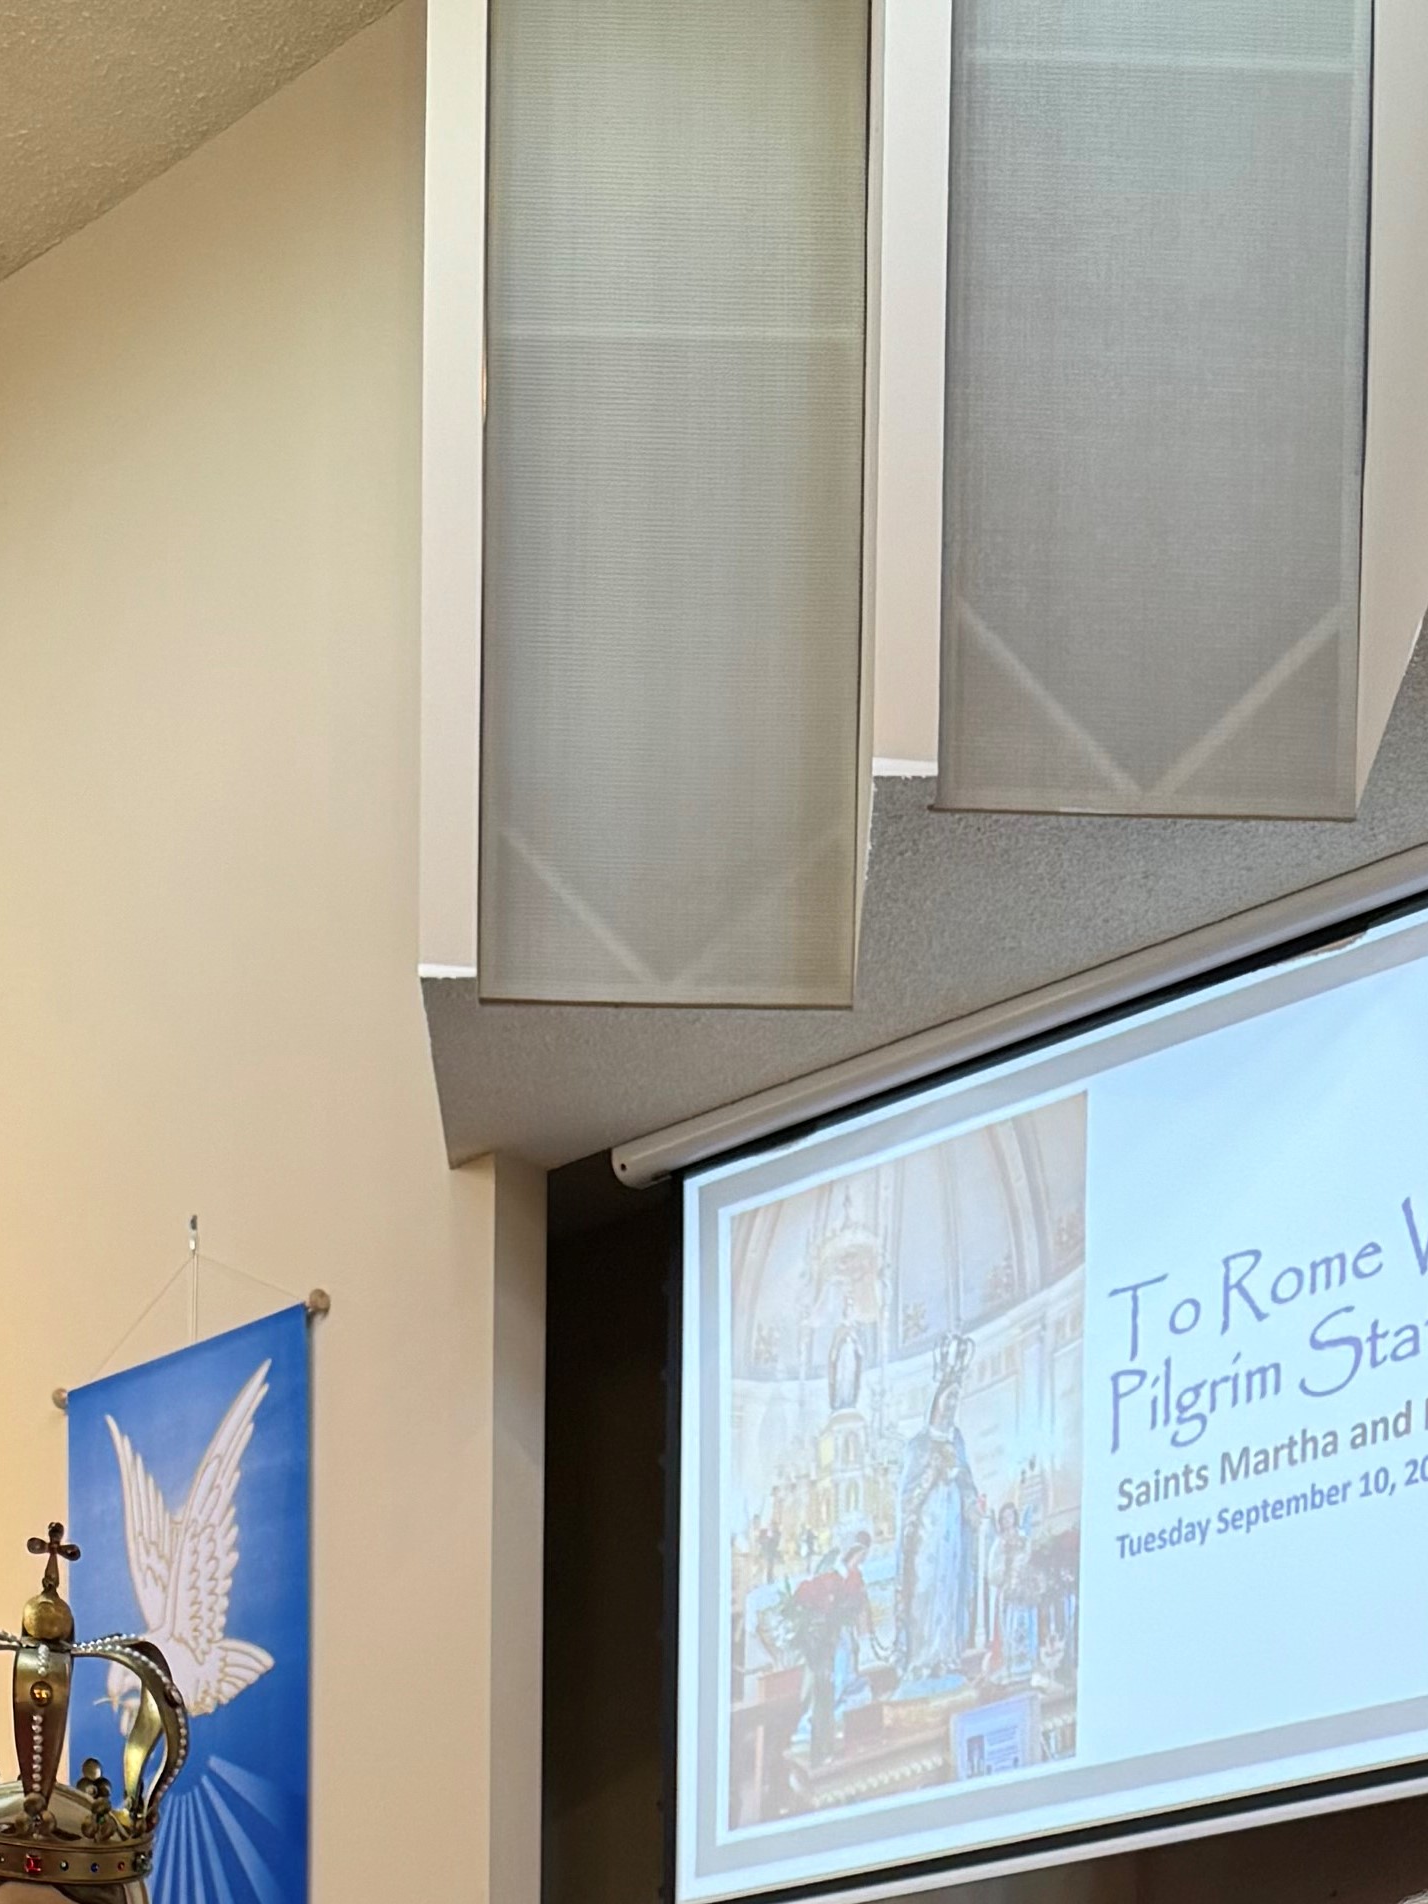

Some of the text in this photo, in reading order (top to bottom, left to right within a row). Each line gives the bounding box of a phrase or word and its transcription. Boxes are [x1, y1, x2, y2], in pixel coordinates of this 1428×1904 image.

[1108, 1272, 1202, 1362] To
[1220, 1241, 1384, 1336] Rome
[1110, 1351, 1282, 1455] Pilgrim
[1117, 1463, 1210, 1512] Saints
[1220, 1428, 1339, 1485] Martha
[1349, 1399, 1413, 1450] and
[1116, 1517, 1211, 1559] Tuesday
[1216, 1481, 1352, 1534] September
[1359, 1466, 1397, 1496] 10,
